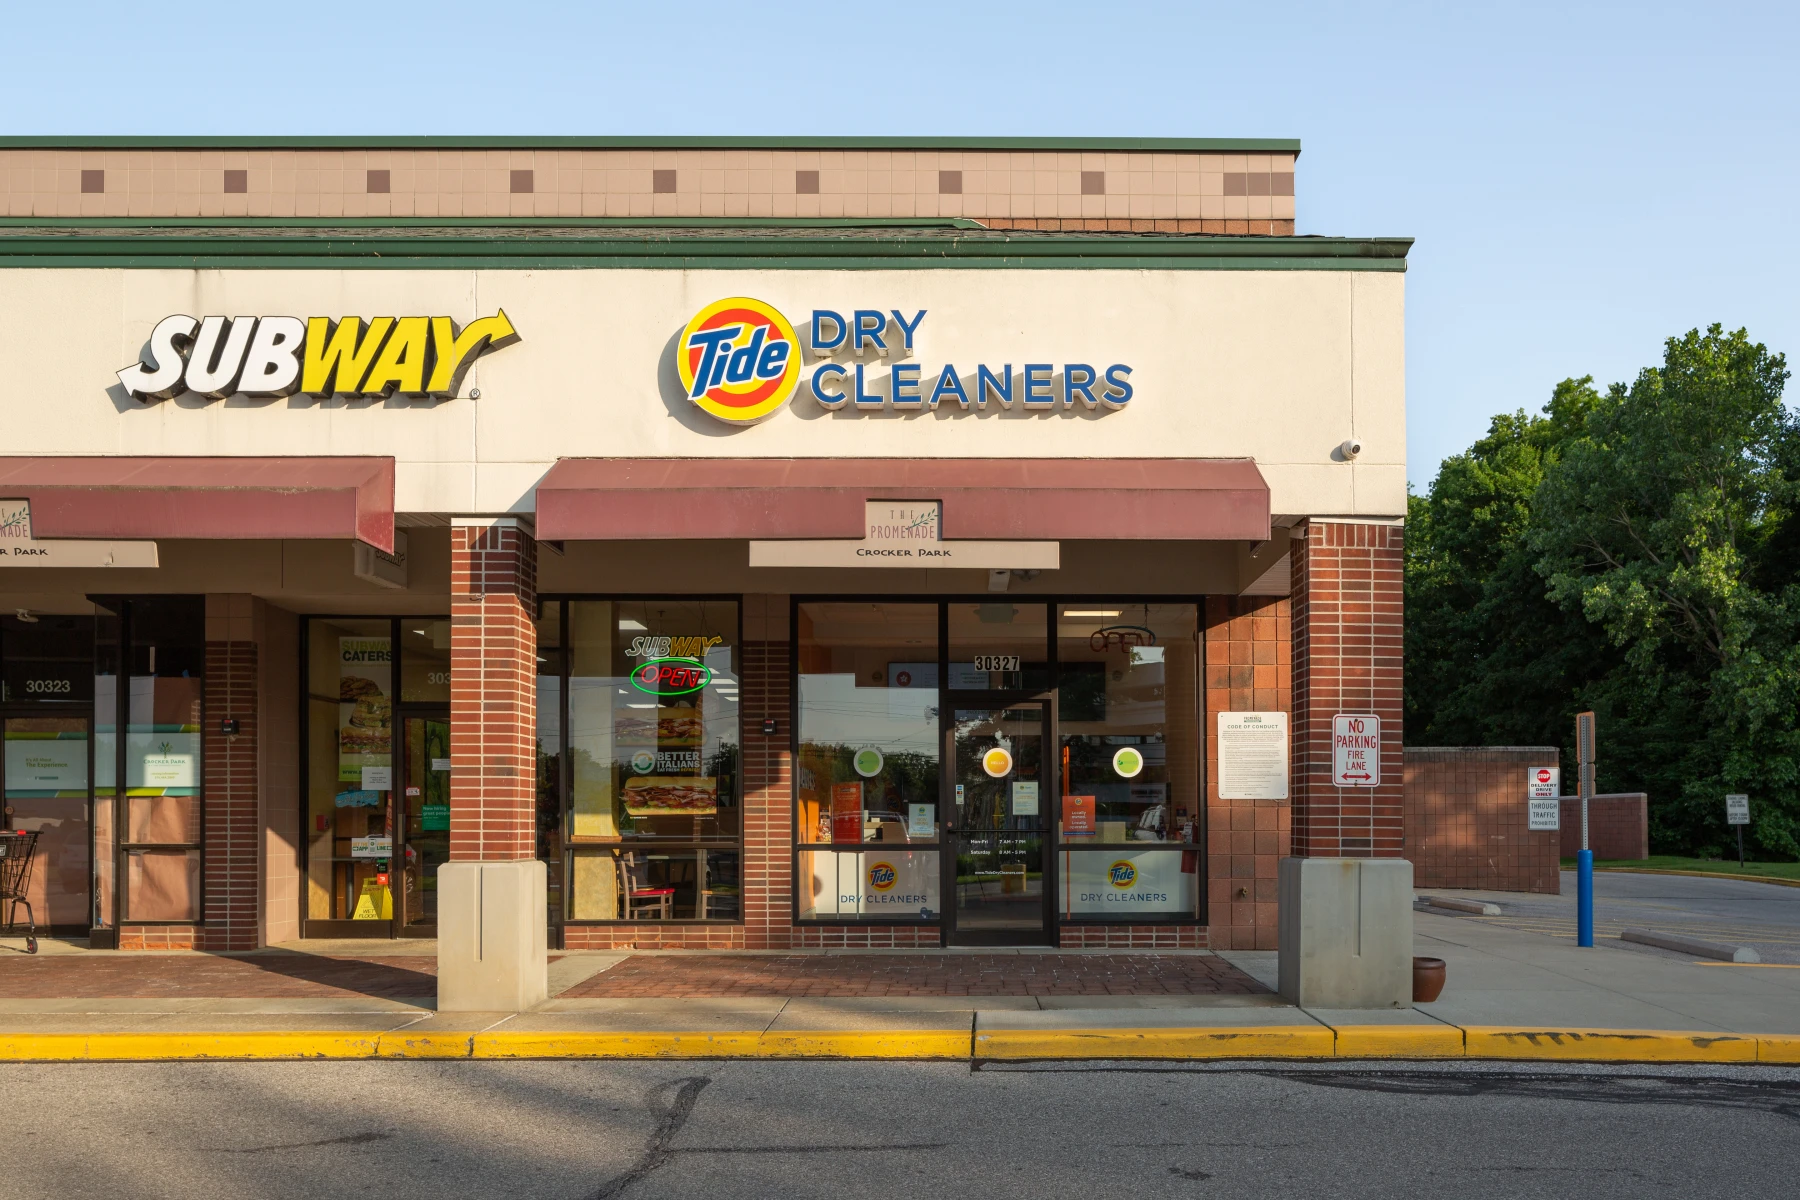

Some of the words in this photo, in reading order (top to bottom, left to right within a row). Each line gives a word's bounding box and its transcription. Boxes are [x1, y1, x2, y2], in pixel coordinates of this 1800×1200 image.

[811, 309, 928, 354] DRY
[116, 308, 520, 397] SUBWAY
[687, 324, 791, 402] Tide
[811, 363, 1134, 407] CLEANERS
[890, 509, 914, 520] THE
[870, 525, 935, 539] PROMENADE
[14, 547, 49, 556] PARK
[856, 548, 913, 557] CROCKER
[918, 548, 952, 557] PARK
[625, 635, 722, 657] SUBWAY
[1090, 630, 1152, 653] OPEN
[342, 650, 392, 662] CATERS
[975, 656, 1019, 671] 30327
[641, 665, 700, 688] OPEN
[26, 680, 70, 693] 30323
[1348, 720, 1365, 734] NO
[1336, 735, 1377, 749] PARKING
[657, 751, 700, 760] BETTER
[1347, 750, 1365, 760] FIRE
[657, 760, 701, 768] ITALIANS
[1345, 761, 1367, 771] LANE
[870, 868, 895, 886] Tide
[1110, 866, 1135, 884] Tide
[840, 894, 862, 903] DRY
[866, 894, 927, 904] CLEANERS
[1080, 893, 1102, 902] DRY
[1106, 893, 1167, 902] CLEANERS
